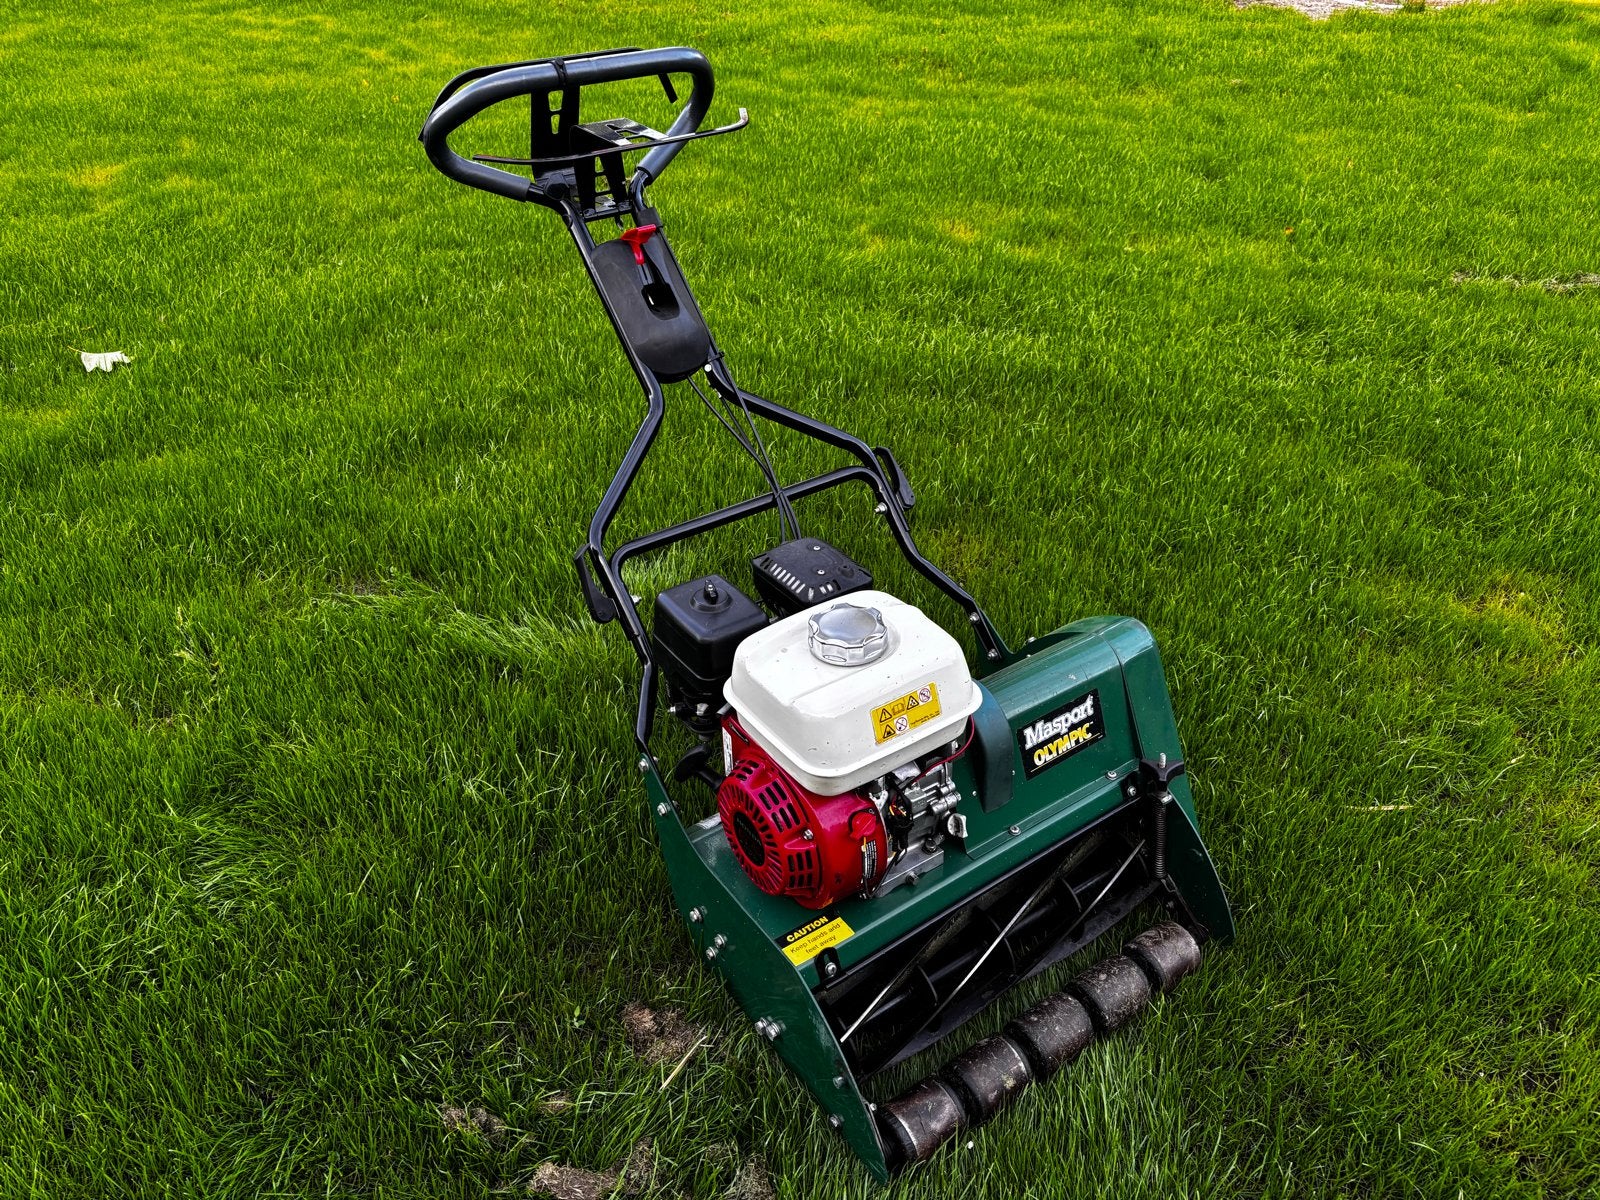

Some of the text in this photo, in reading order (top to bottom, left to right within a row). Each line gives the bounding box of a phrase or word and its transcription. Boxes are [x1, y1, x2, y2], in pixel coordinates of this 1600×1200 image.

[1023, 694, 1094, 750] Masport
[1033, 723, 1092, 766] OLYMPIC
[786, 916, 829, 942] CAUTION
[790, 923, 841, 953] Keep hands and
[805, 935, 837, 955] feet away
